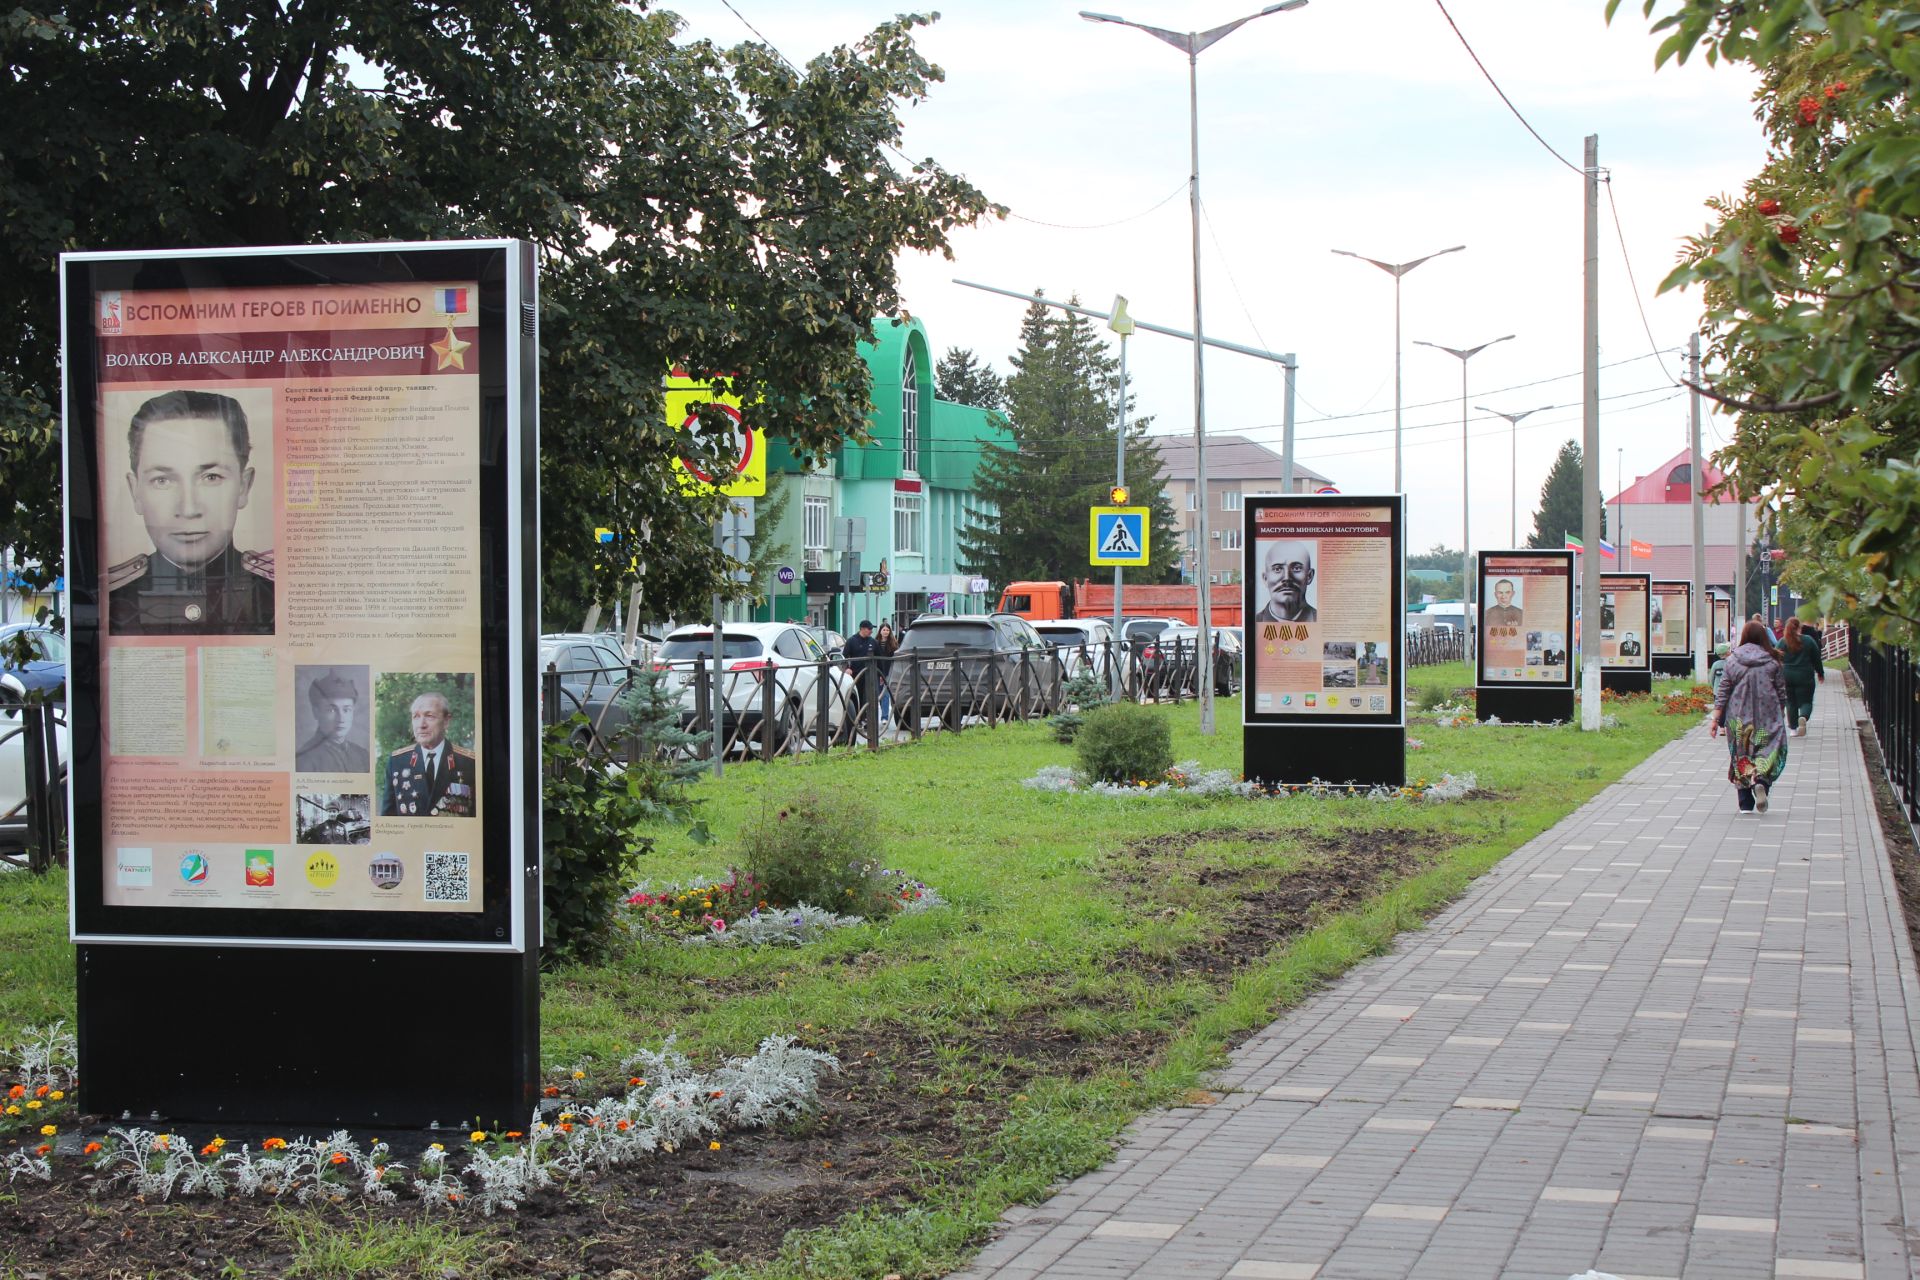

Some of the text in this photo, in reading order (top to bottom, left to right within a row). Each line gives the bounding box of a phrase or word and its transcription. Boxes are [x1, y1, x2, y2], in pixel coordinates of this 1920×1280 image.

[126, 297, 421, 320] ВСПОМНИМ ГЕРОЕВ ПОИМЕННО
[106, 346, 425, 367] ВОЛКОВ АЛЕКСАНДР АЛЕКСАНДРОВИЧ
[780, 571, 794, 580] WB
[972, 579, 989, 592] OZON
